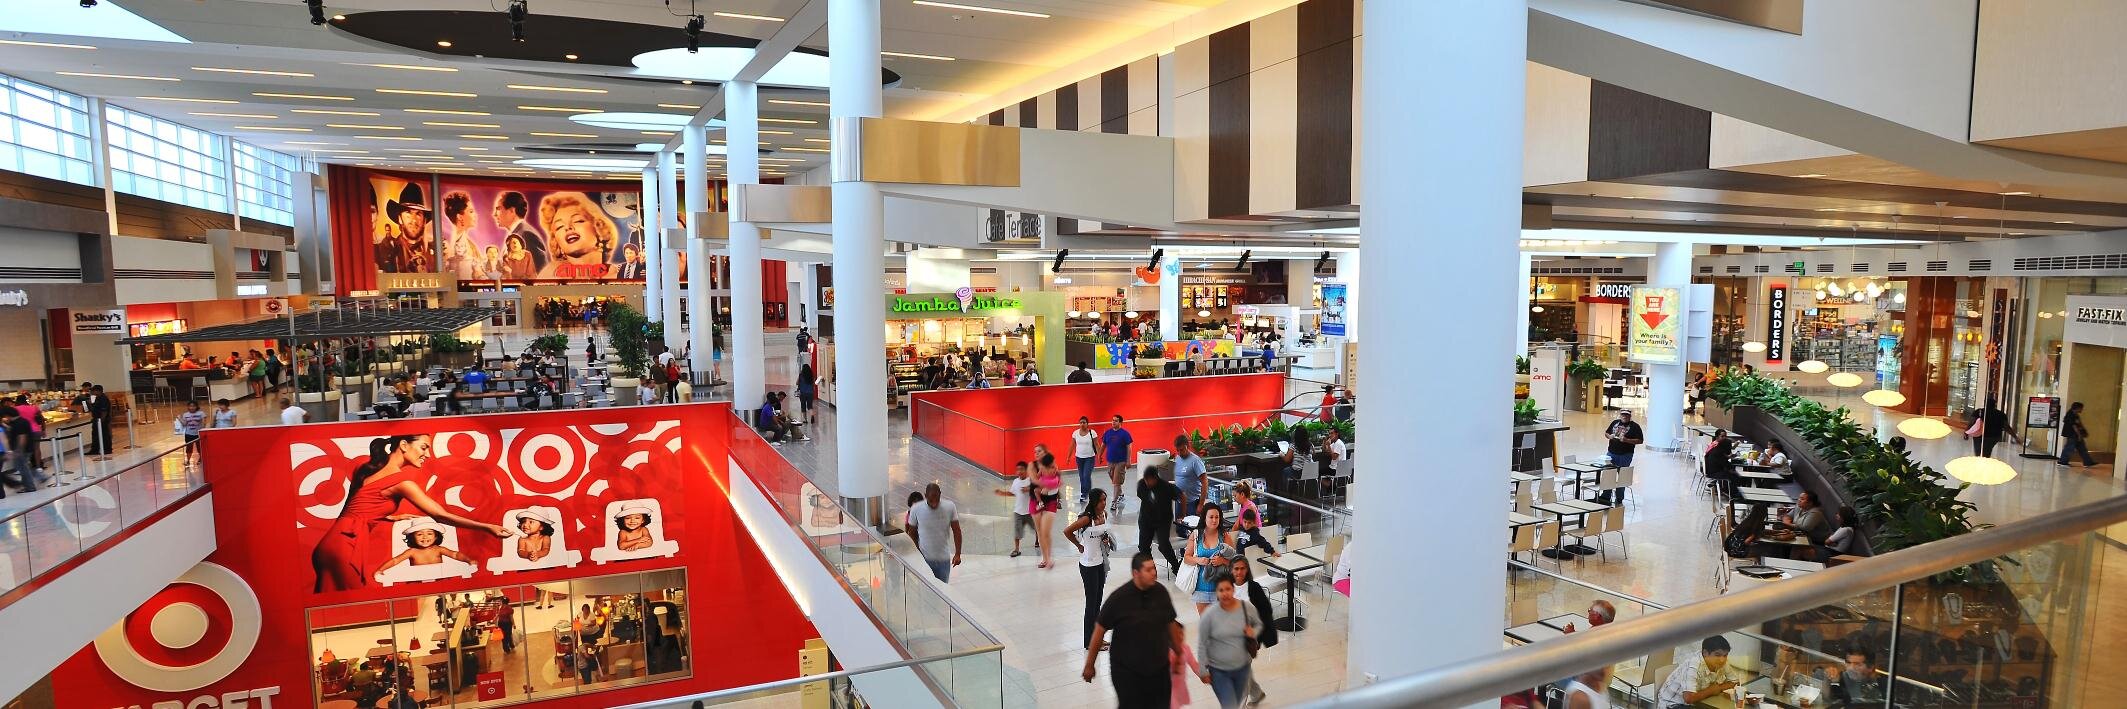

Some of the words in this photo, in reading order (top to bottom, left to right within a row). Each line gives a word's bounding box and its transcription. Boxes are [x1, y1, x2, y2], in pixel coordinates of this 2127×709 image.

[985, 213, 1004, 240] Cafe
[1006, 213, 1041, 238] Terrace
[893, 297, 960, 312] Jamba
[972, 296, 1021, 310] Juice
[74, 313, 121, 322] Sharky's
[1772, 290, 1783, 359] BORDERS
